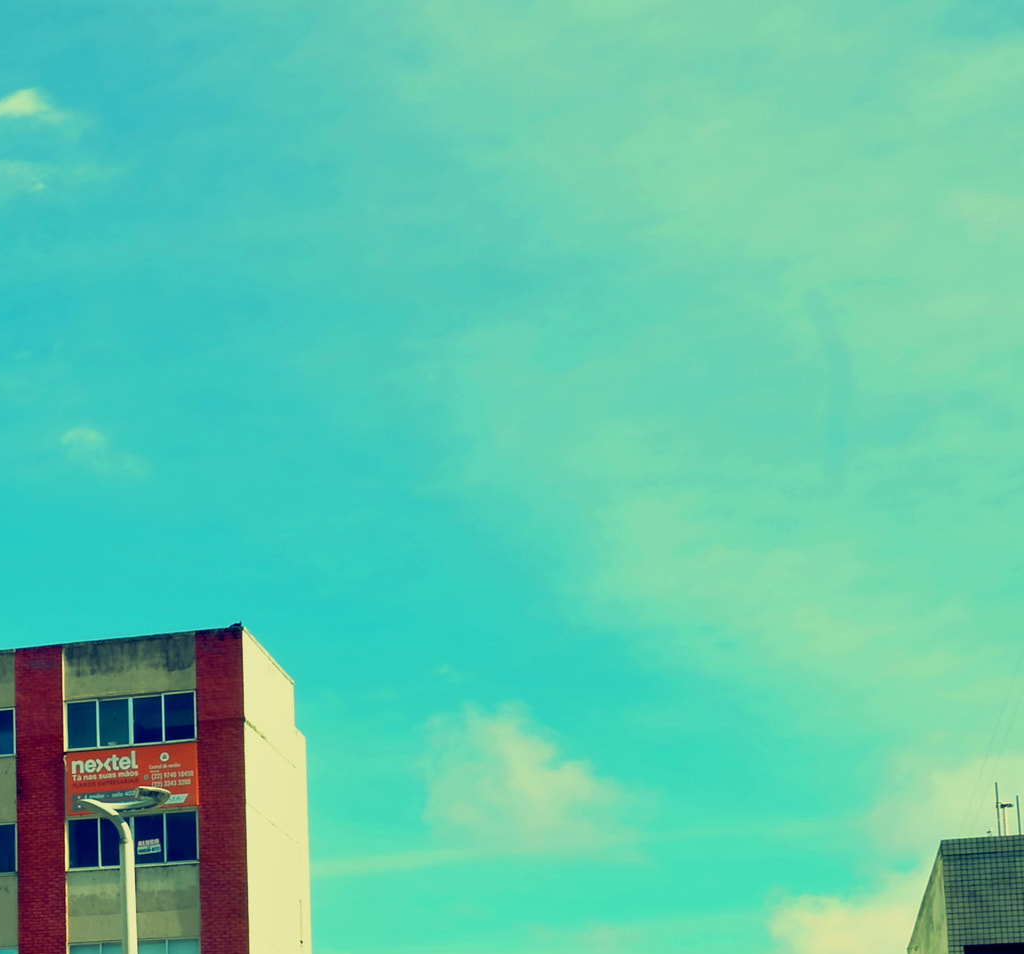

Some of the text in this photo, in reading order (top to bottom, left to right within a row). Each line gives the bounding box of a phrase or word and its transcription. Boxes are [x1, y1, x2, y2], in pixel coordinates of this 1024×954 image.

[71, 750, 138, 774] nextel
[99, 772, 117, 780] suas
[118, 770, 139, 778] mãos
